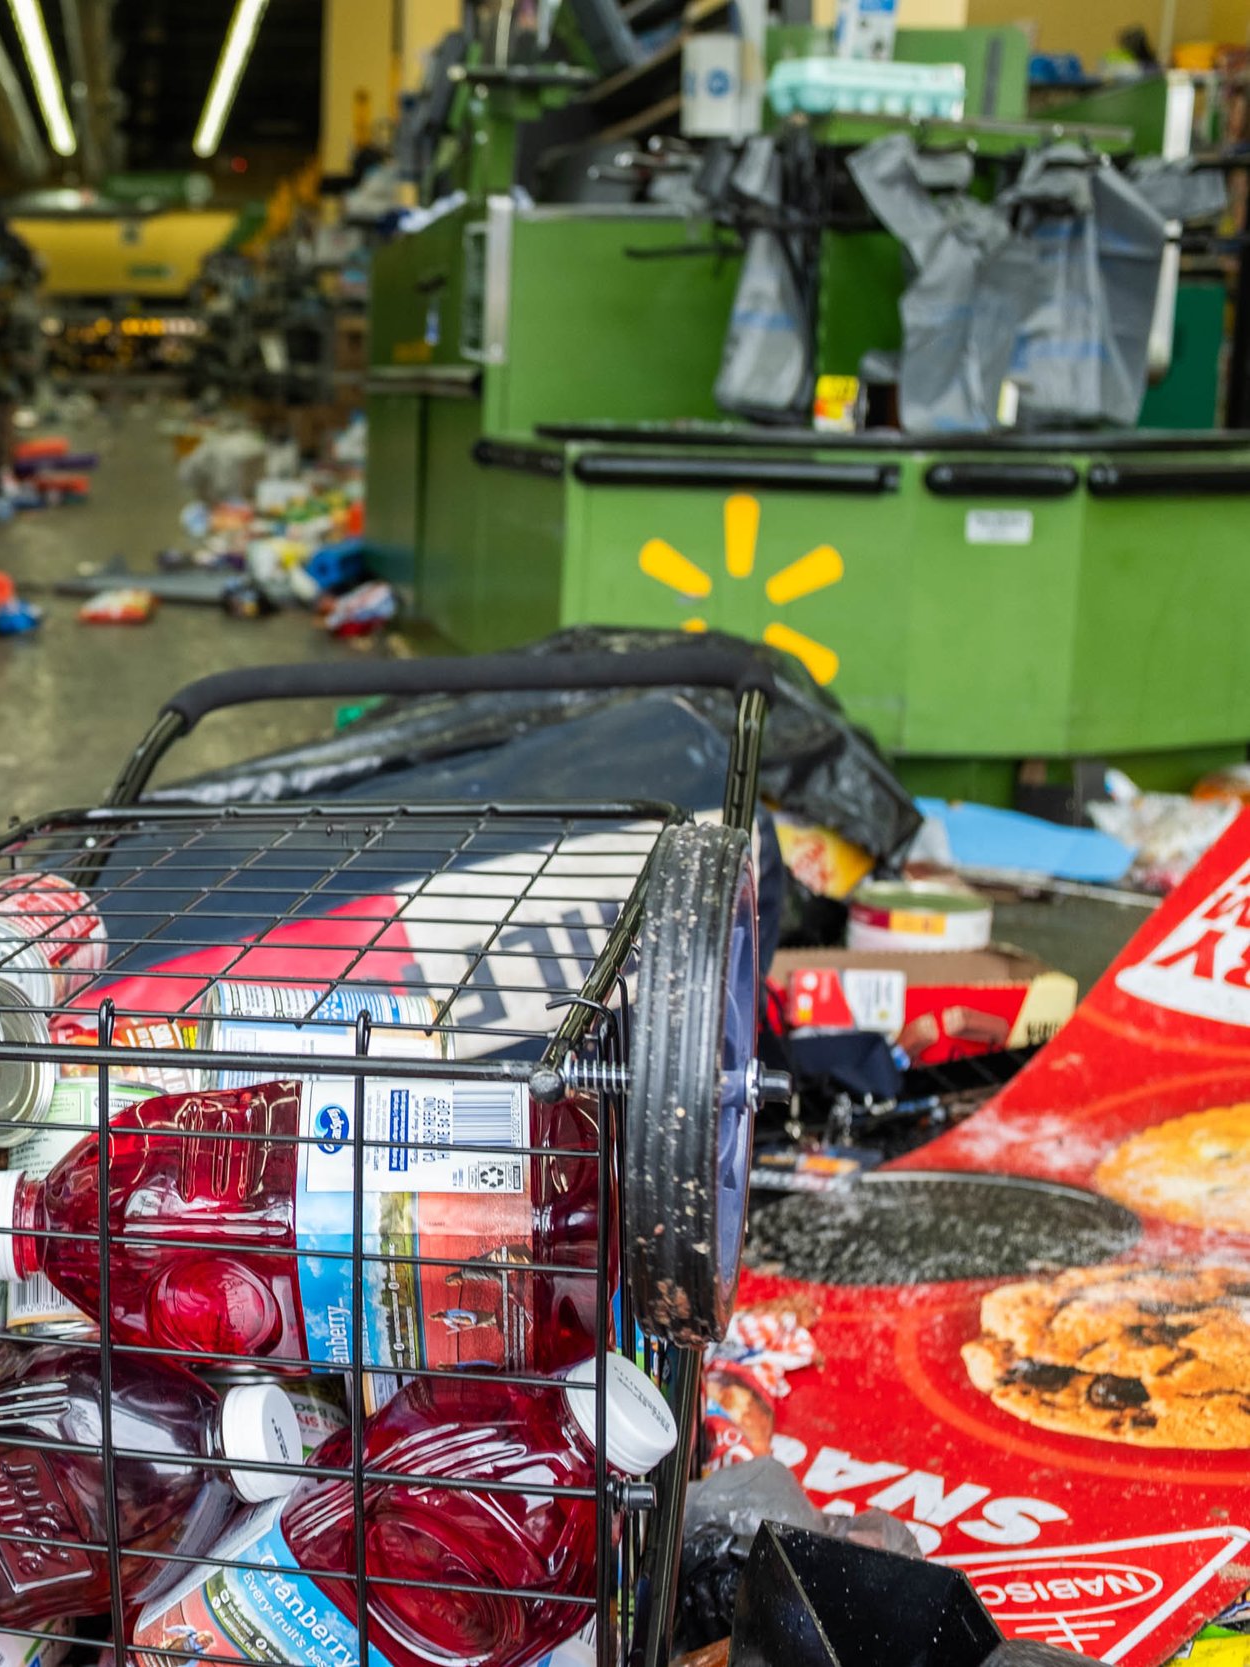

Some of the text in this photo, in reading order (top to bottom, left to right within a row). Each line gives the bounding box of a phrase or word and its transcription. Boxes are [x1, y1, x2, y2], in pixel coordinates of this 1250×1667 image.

[423, 1096, 436, 1126] REFUND
[437, 1099, 450, 1115] DEP
[260, 1554, 360, 1667] Cranberry
